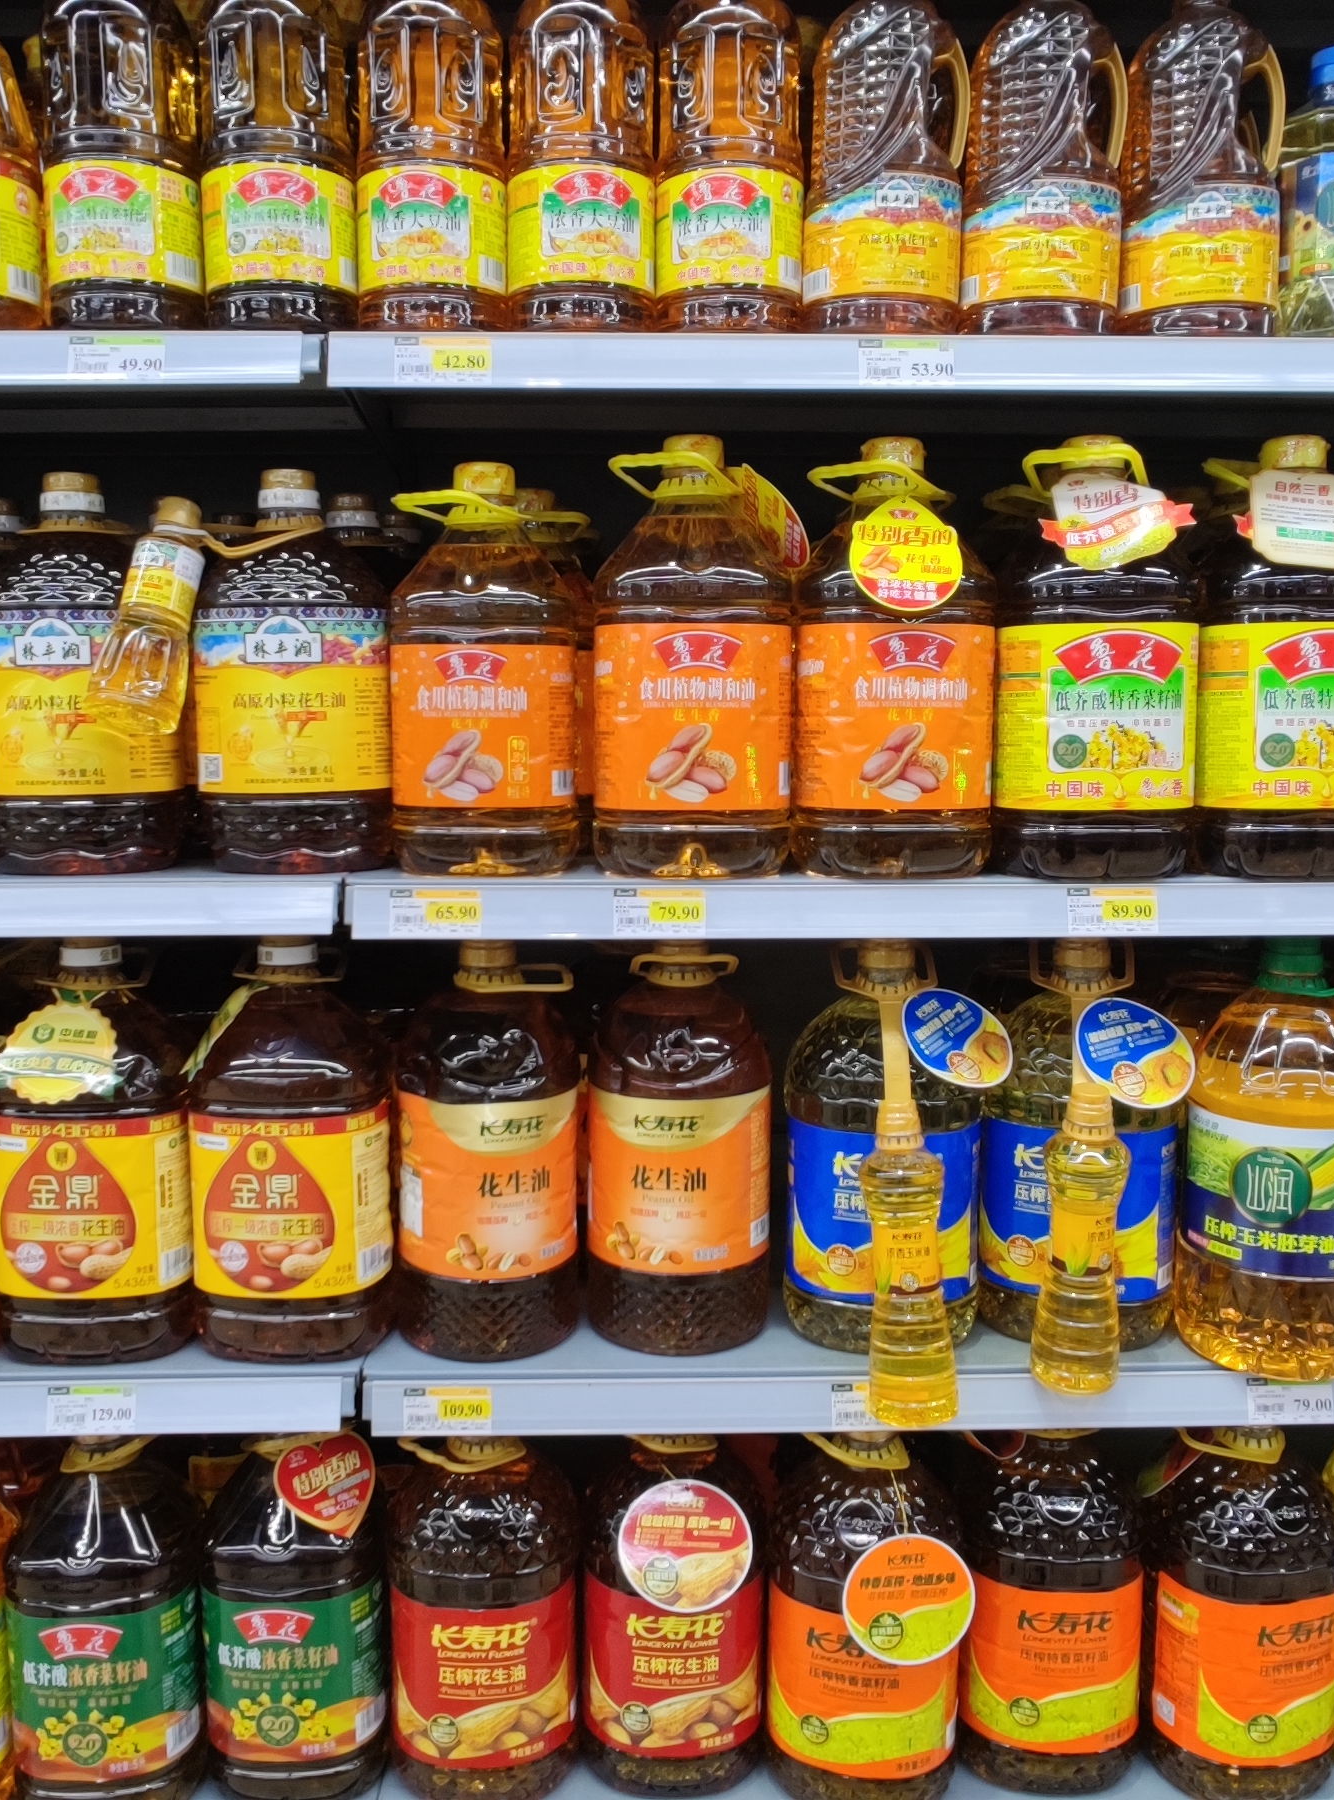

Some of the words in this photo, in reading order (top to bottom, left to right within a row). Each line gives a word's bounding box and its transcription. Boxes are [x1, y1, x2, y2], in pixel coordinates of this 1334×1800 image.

[377, 210, 462, 231] 浓香大豆油
[549, 209, 635, 234] 浓香大豆油
[678, 210, 763, 233] 浓香大豆油
[119, 358, 162, 371] 49.90
[442, 355, 485, 369] 42.80
[911, 362, 954, 377] 53.90
[1073, 484, 1139, 511] 特别香
[1275, 481, 1330, 497] 自然三香
[859, 525, 952, 546] 特别香的
[669, 637, 727, 664] 鲁花
[884, 636, 942, 664] 鲁花
[1086, 638, 1157, 671] 鲁花
[446, 653, 493, 676] 鲁花
[416, 685, 528, 711] 食用植物调和油
[639, 677, 756, 700] 食用植物调和油
[854, 677, 968, 701] 食用植物调和油
[233, 692, 346, 709] 高原小粒花生油
[1056, 689, 1183, 712] 低芥酸特香菜籽油
[1046, 780, 1104, 798] 中国味
[1253, 780, 1311, 798] 中国味
[435, 906, 477, 919] 65.90
[658, 906, 700, 919] 79.90
[1112, 904, 1152, 918] 89.90
[477, 1165, 551, 1198] 花生油
[631, 1164, 707, 1192] 花生油
[1247, 1162, 1293, 1214] 山润
[28, 1175, 99, 1210] 金鼎
[230, 1173, 298, 1210] 金鼎
[91, 1408, 132, 1421] 129.00
[442, 1404, 482, 1417] 109.90
[1294, 1398, 1332, 1411] 79.00
[248, 1615, 299, 1639] 鲁花
[626, 1613, 725, 1639] 长寿花
[1017, 1609, 1114, 1634] 长寿花
[59, 1629, 107, 1652] 鲁花
[431, 1620, 532, 1650] 长寿花
[632, 1638, 679, 1650] LONGEVITY
[682, 1638, 719, 1649] FLOWER
[1022, 1634, 1072, 1645] LONGEVITY
[1074, 1636, 1107, 1645] FLOWER
[438, 1648, 486, 1659] LONGEVITY
[488, 1648, 525, 1659] FLOWER
[811, 1652, 859, 1668] LONGEVITY
[1020, 1649, 1108, 1663] 压榨特香菜籽油
[438, 1664, 527, 1686] 压榨花生油
[633, 1654, 720, 1676] 压榨花生油
[478, 1685, 507, 1695] Peanut
[510, 1684, 524, 1692] Oil
[671, 1675, 701, 1685] Peanut
[703, 1674, 717, 1683] Oil
